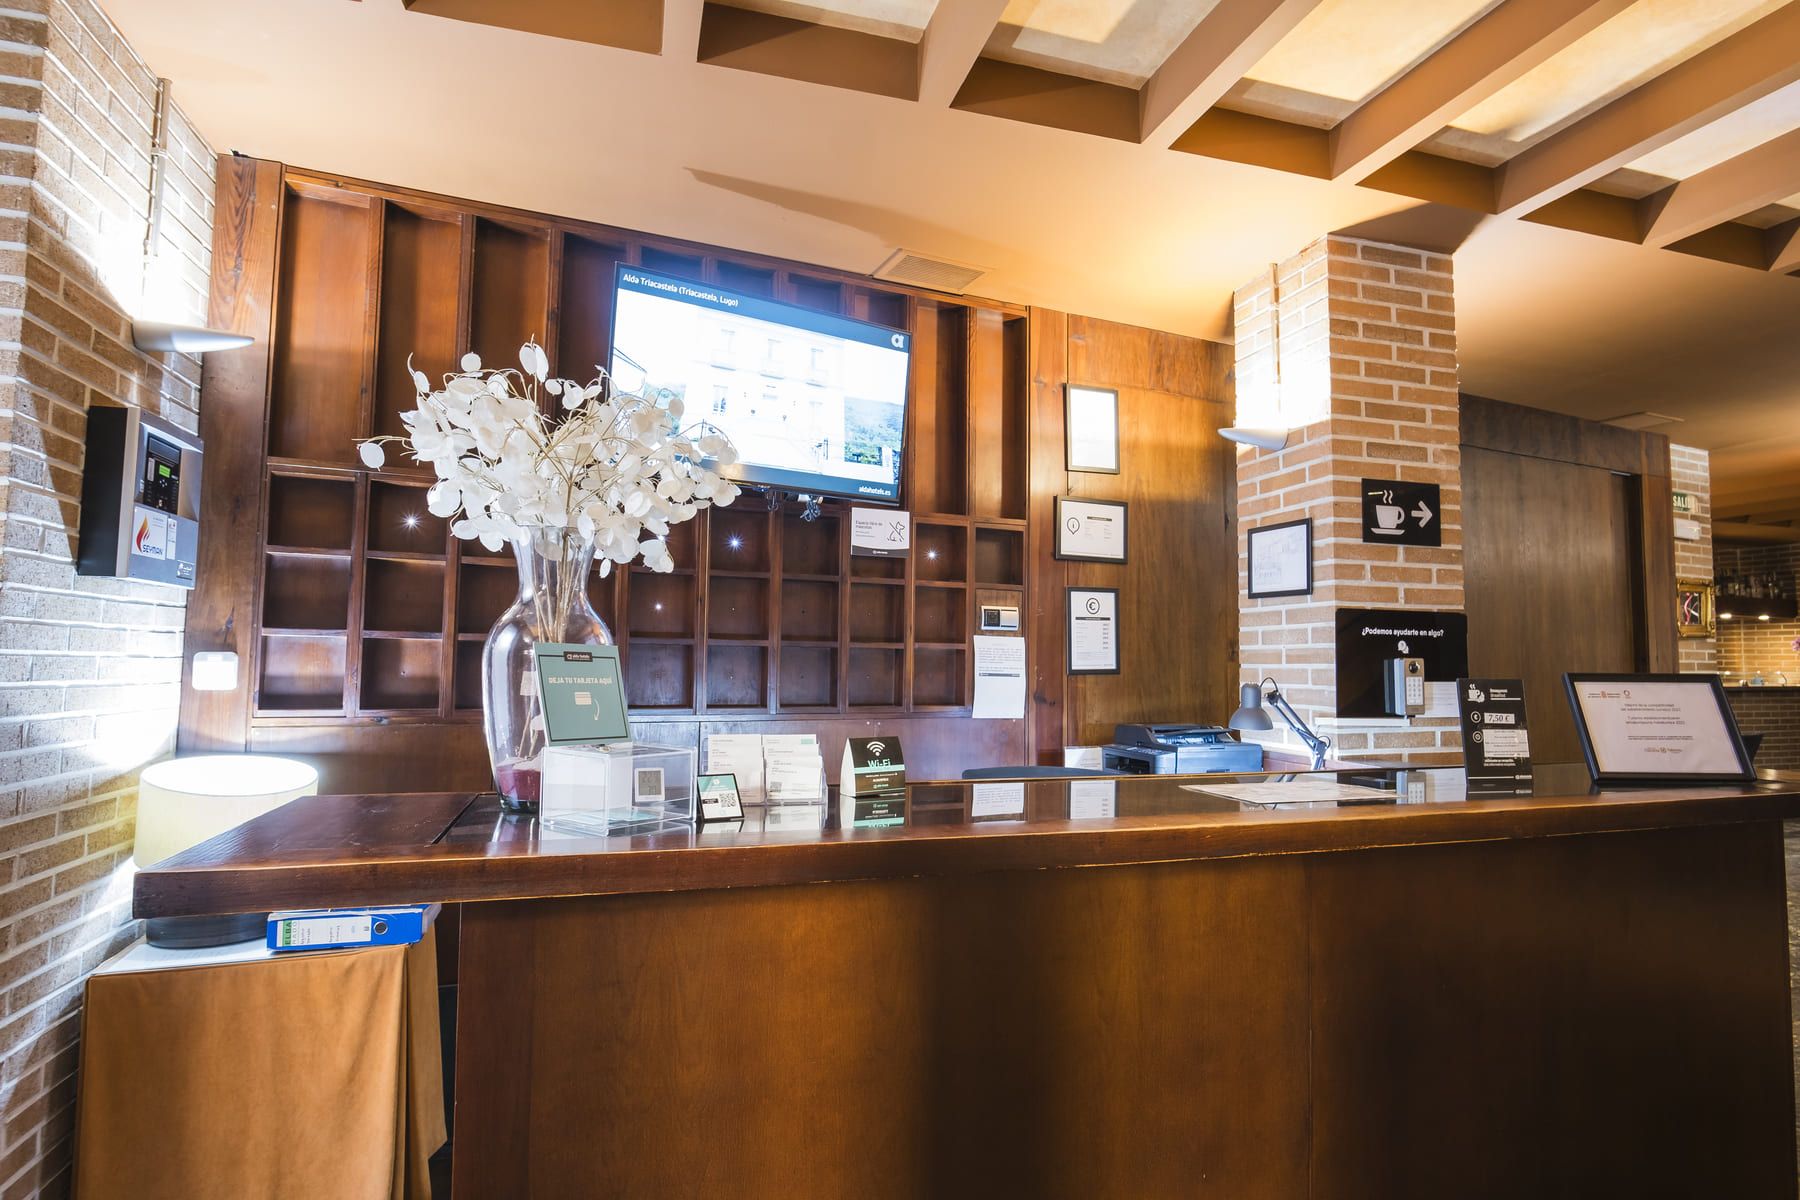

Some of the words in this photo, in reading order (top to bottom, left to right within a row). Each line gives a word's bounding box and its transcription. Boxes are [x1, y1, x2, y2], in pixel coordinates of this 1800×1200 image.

[623, 274, 639, 284] Alda
[640, 277, 678, 293] Triacastela
[679, 286, 719, 303] (Triacastela,
[720, 296, 739, 307] Lugo)
[858, 486, 891, 496] aldahotels.es
[1361, 626, 1392, 636] ¿Podemos
[1393, 628, 1419, 637] ayudarte
[1428, 628, 1444, 638] algo?
[1488, 714, 1504, 722] 7,50
[867, 758, 891, 768] Wi-Fi
